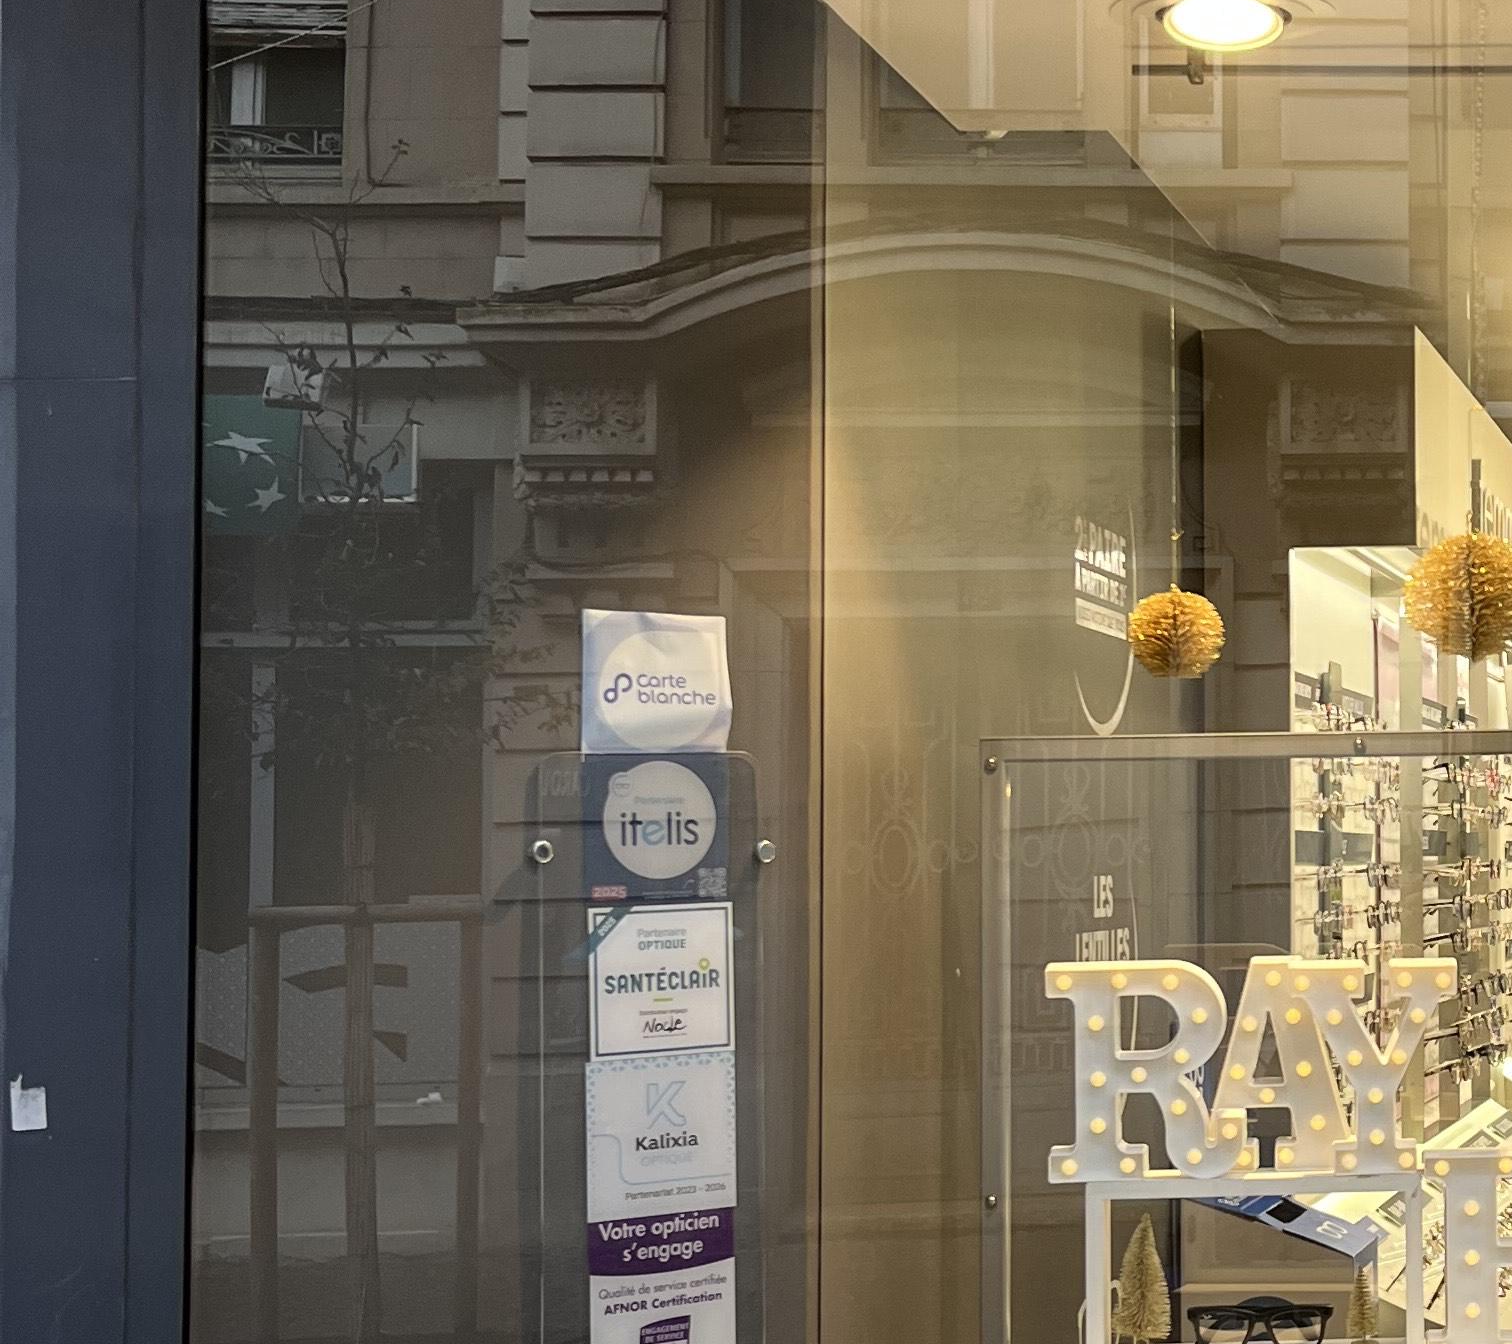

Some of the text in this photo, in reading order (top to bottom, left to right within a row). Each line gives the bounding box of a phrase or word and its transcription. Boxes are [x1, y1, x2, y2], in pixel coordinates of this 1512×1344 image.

[636, 673, 687, 689] Carte
[637, 690, 717, 705] blanche
[620, 811, 700, 847] itelis
[1093, 874, 1114, 918] LES
[637, 938, 687, 951] OPTIQUE
[604, 959, 721, 995] SANTÉCLAIR
[1044, 955, 1458, 1185] RAY
[635, 1130, 699, 1152] Kalixia
[598, 1211, 720, 1241] Votre opticien
[622, 1240, 704, 1263] s'engage
[598, 1285, 636, 1301] Qualité
[638, 1282, 651, 1296] de
[653, 1280, 688, 1293] service
[603, 1290, 723, 1316] AFNOR Certification
